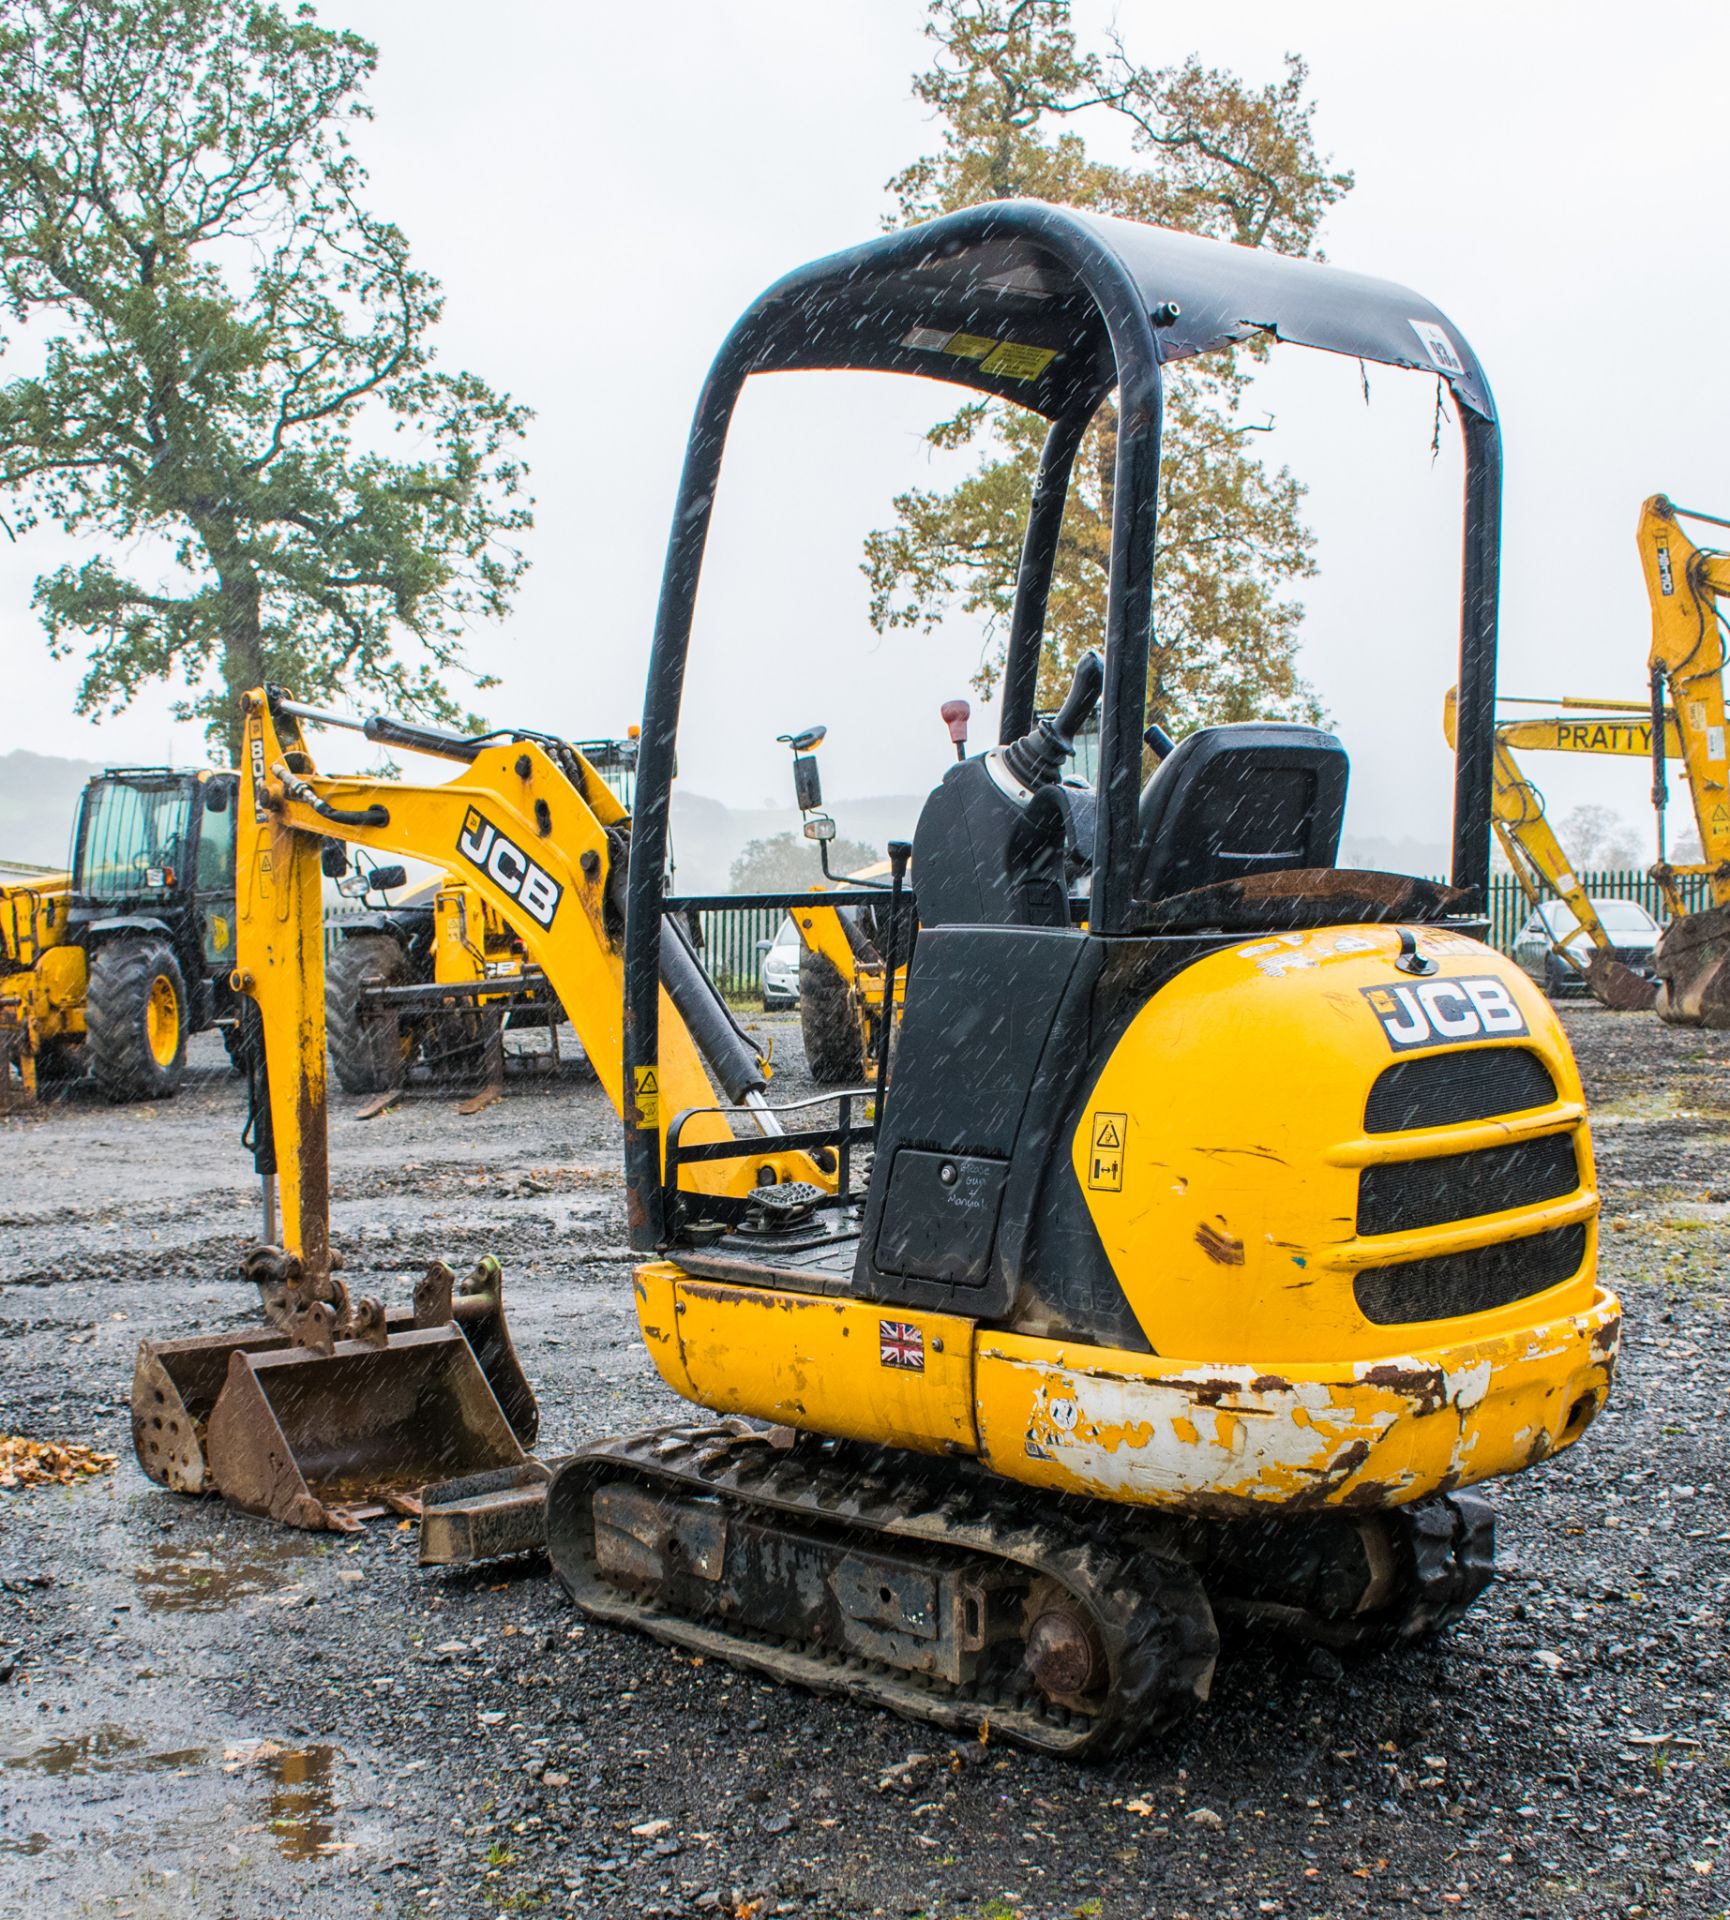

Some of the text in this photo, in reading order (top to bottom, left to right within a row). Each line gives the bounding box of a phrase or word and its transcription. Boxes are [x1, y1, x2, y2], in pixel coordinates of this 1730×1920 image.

[1557, 725, 1654, 751] PRATTY
[460, 824, 559, 924] JCB
[485, 961, 517, 977] CB
[1383, 979, 1524, 1044] JCB
